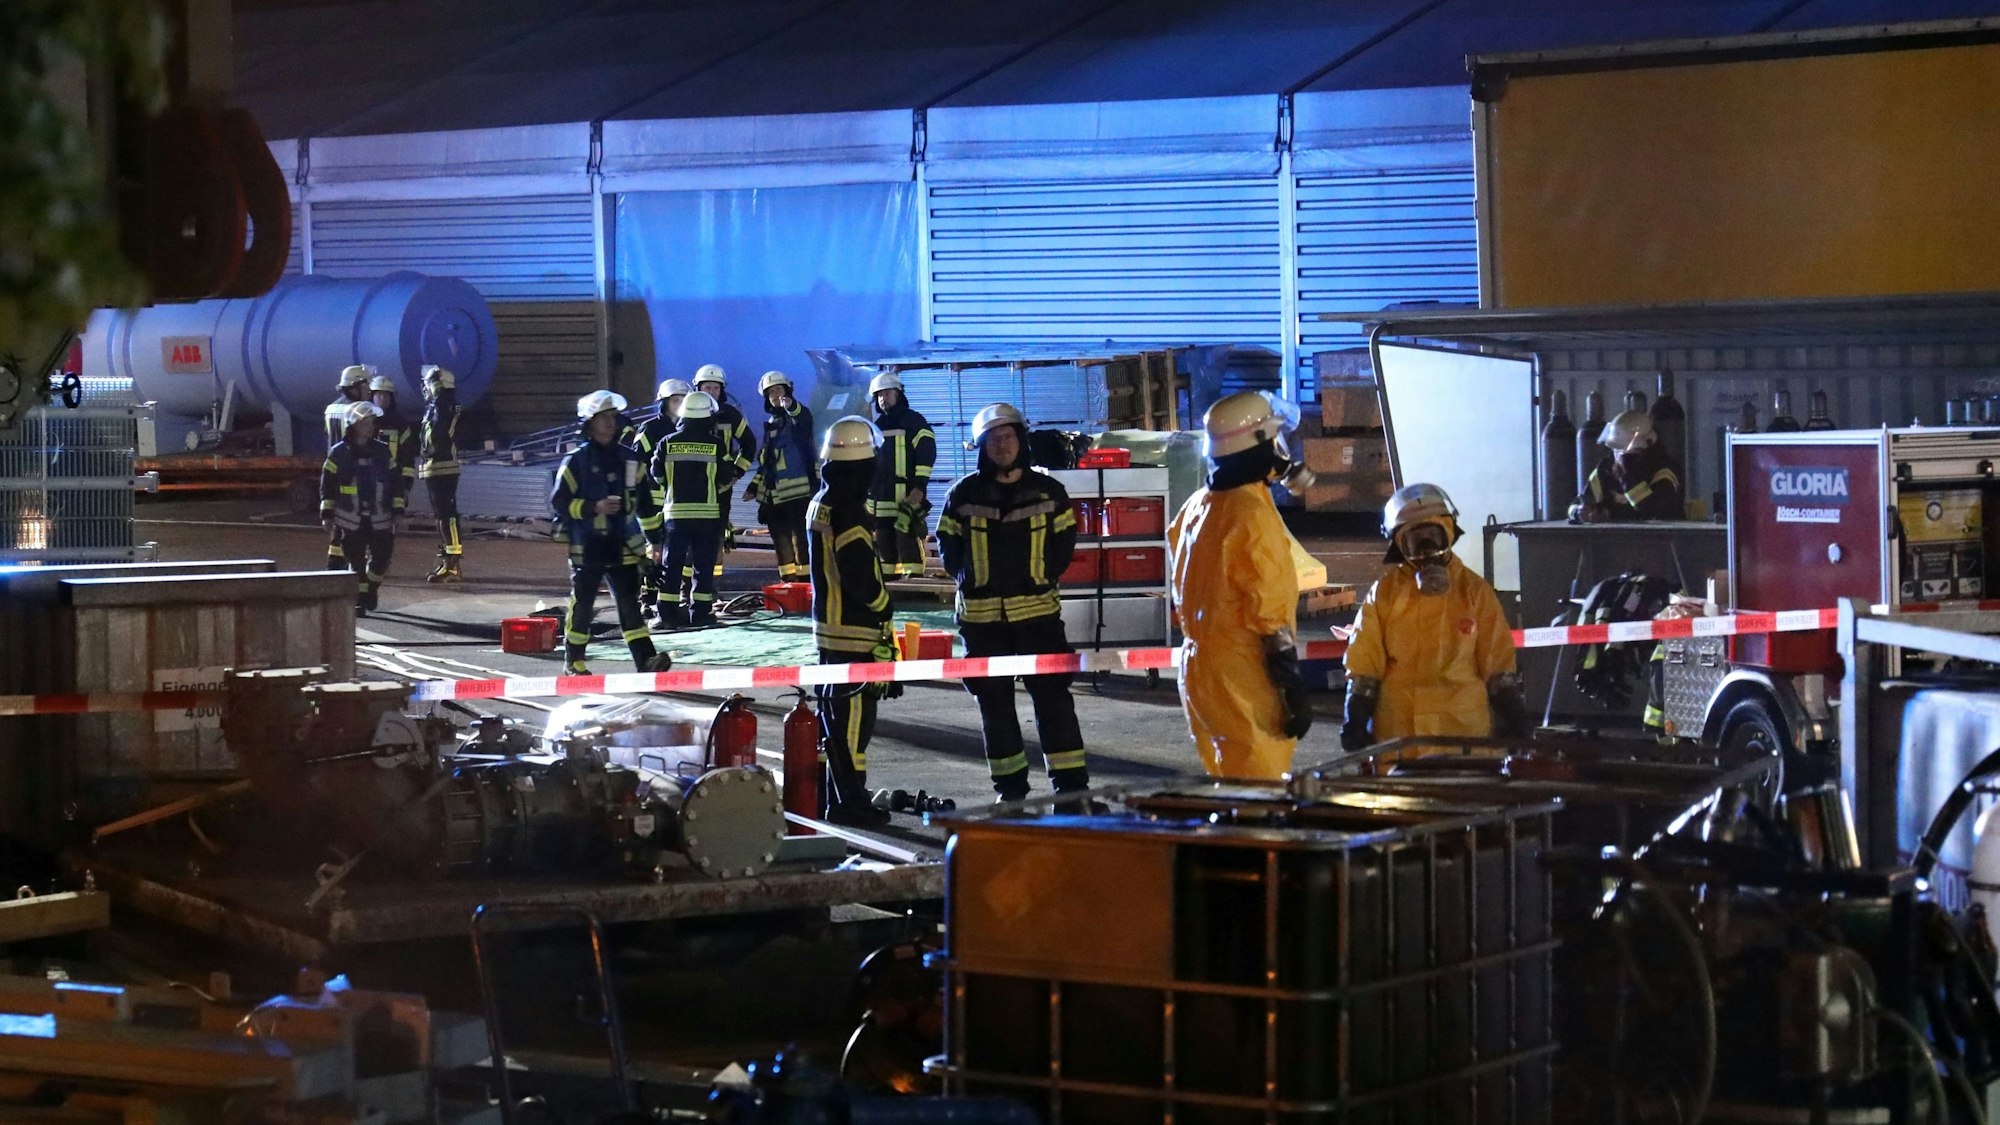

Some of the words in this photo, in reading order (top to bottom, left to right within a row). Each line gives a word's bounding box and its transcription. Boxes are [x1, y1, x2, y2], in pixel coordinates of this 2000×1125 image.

[171, 345, 202, 364] ABB
[1771, 472, 1848, 496] GLORIA
[162, 681, 226, 693] Eigenge
